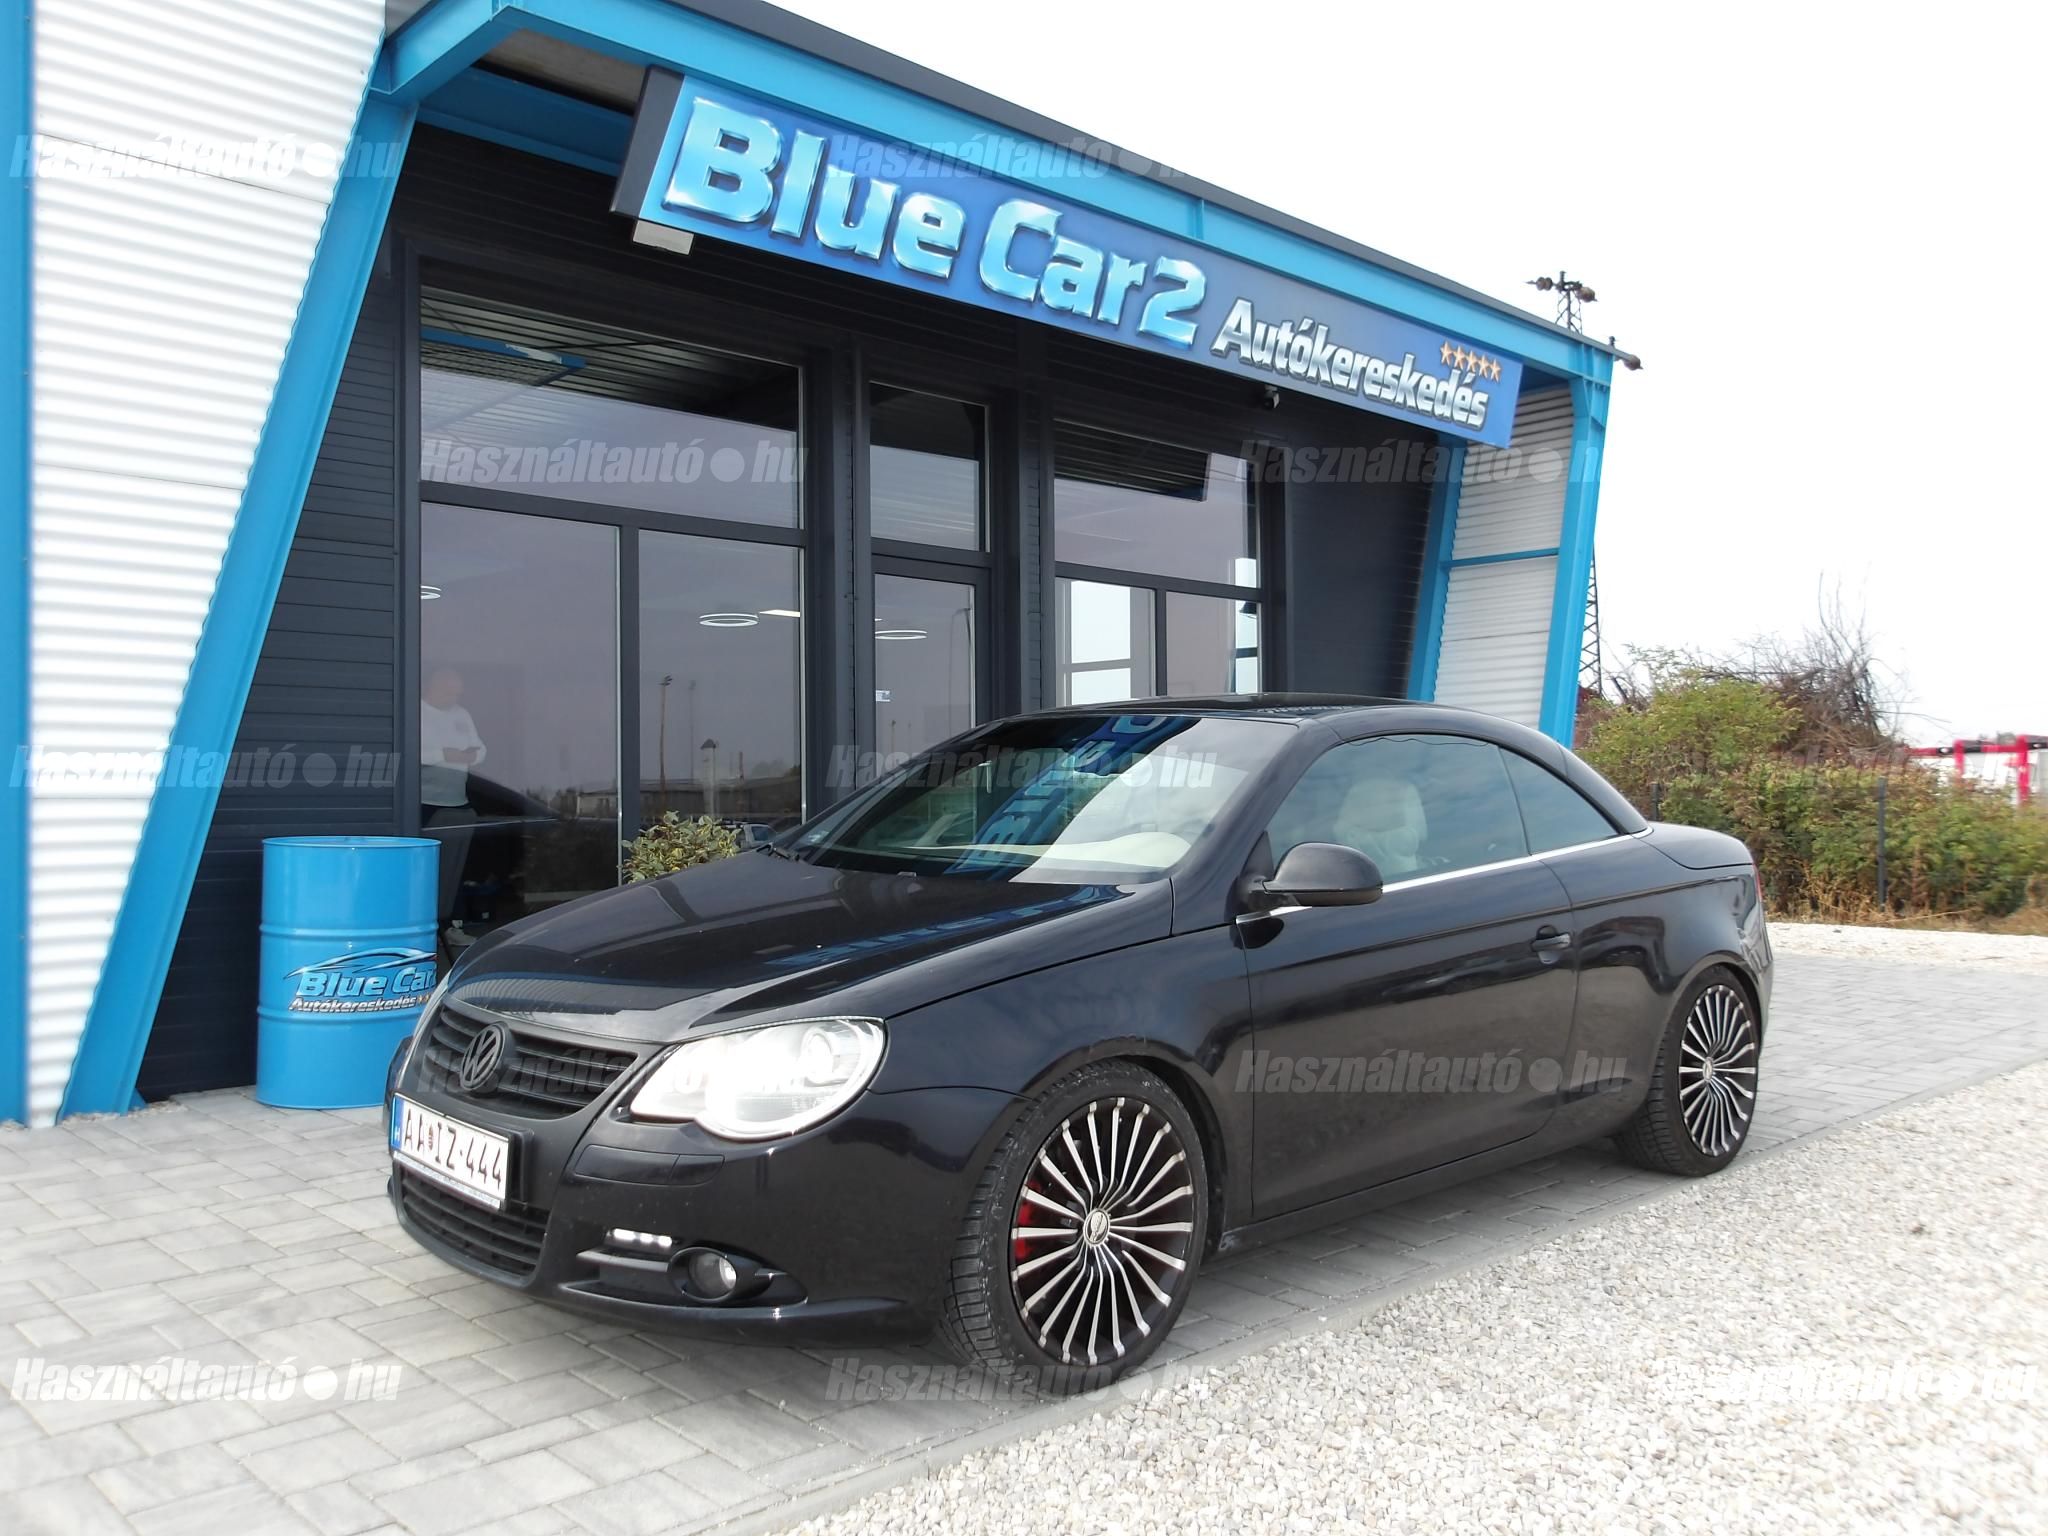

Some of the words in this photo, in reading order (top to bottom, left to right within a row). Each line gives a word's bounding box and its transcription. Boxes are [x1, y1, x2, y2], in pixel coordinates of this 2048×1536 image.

[663, 97, 968, 279] Blue
[1210, 297, 1490, 431] Autókereskedés
[289, 994, 418, 1014] Autókereskedés
[295, 971, 388, 998] Blue
